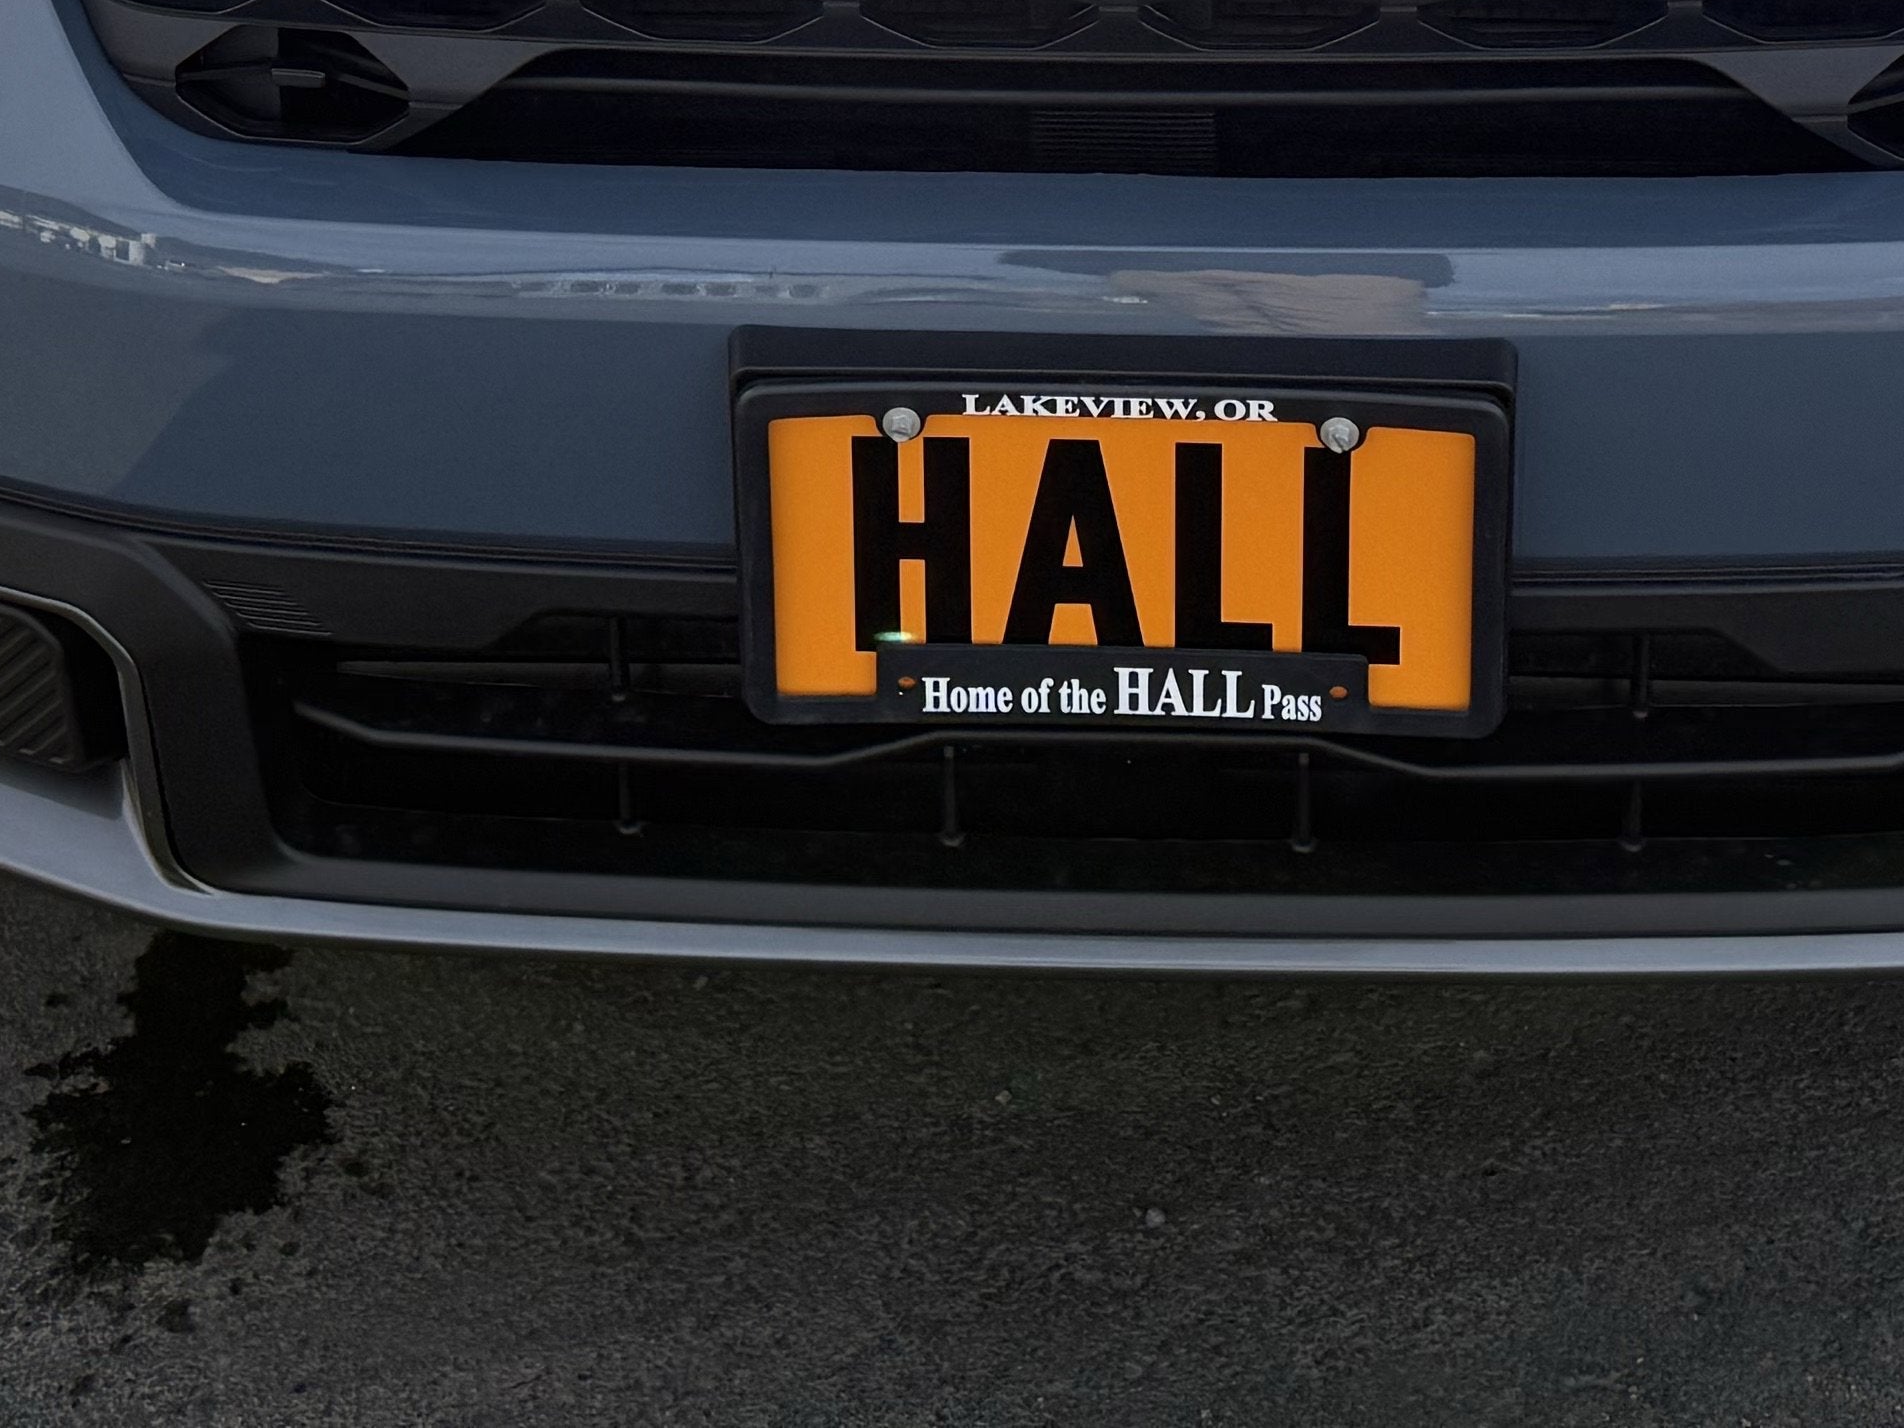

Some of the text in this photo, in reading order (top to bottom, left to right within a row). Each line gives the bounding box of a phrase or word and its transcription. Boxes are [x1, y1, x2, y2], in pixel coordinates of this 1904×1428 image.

[961, 393, 1278, 423] LAKEVIEW, OR
[851, 435, 1401, 665] HALL
[921, 666, 1323, 722] Home of the HALL Pass
